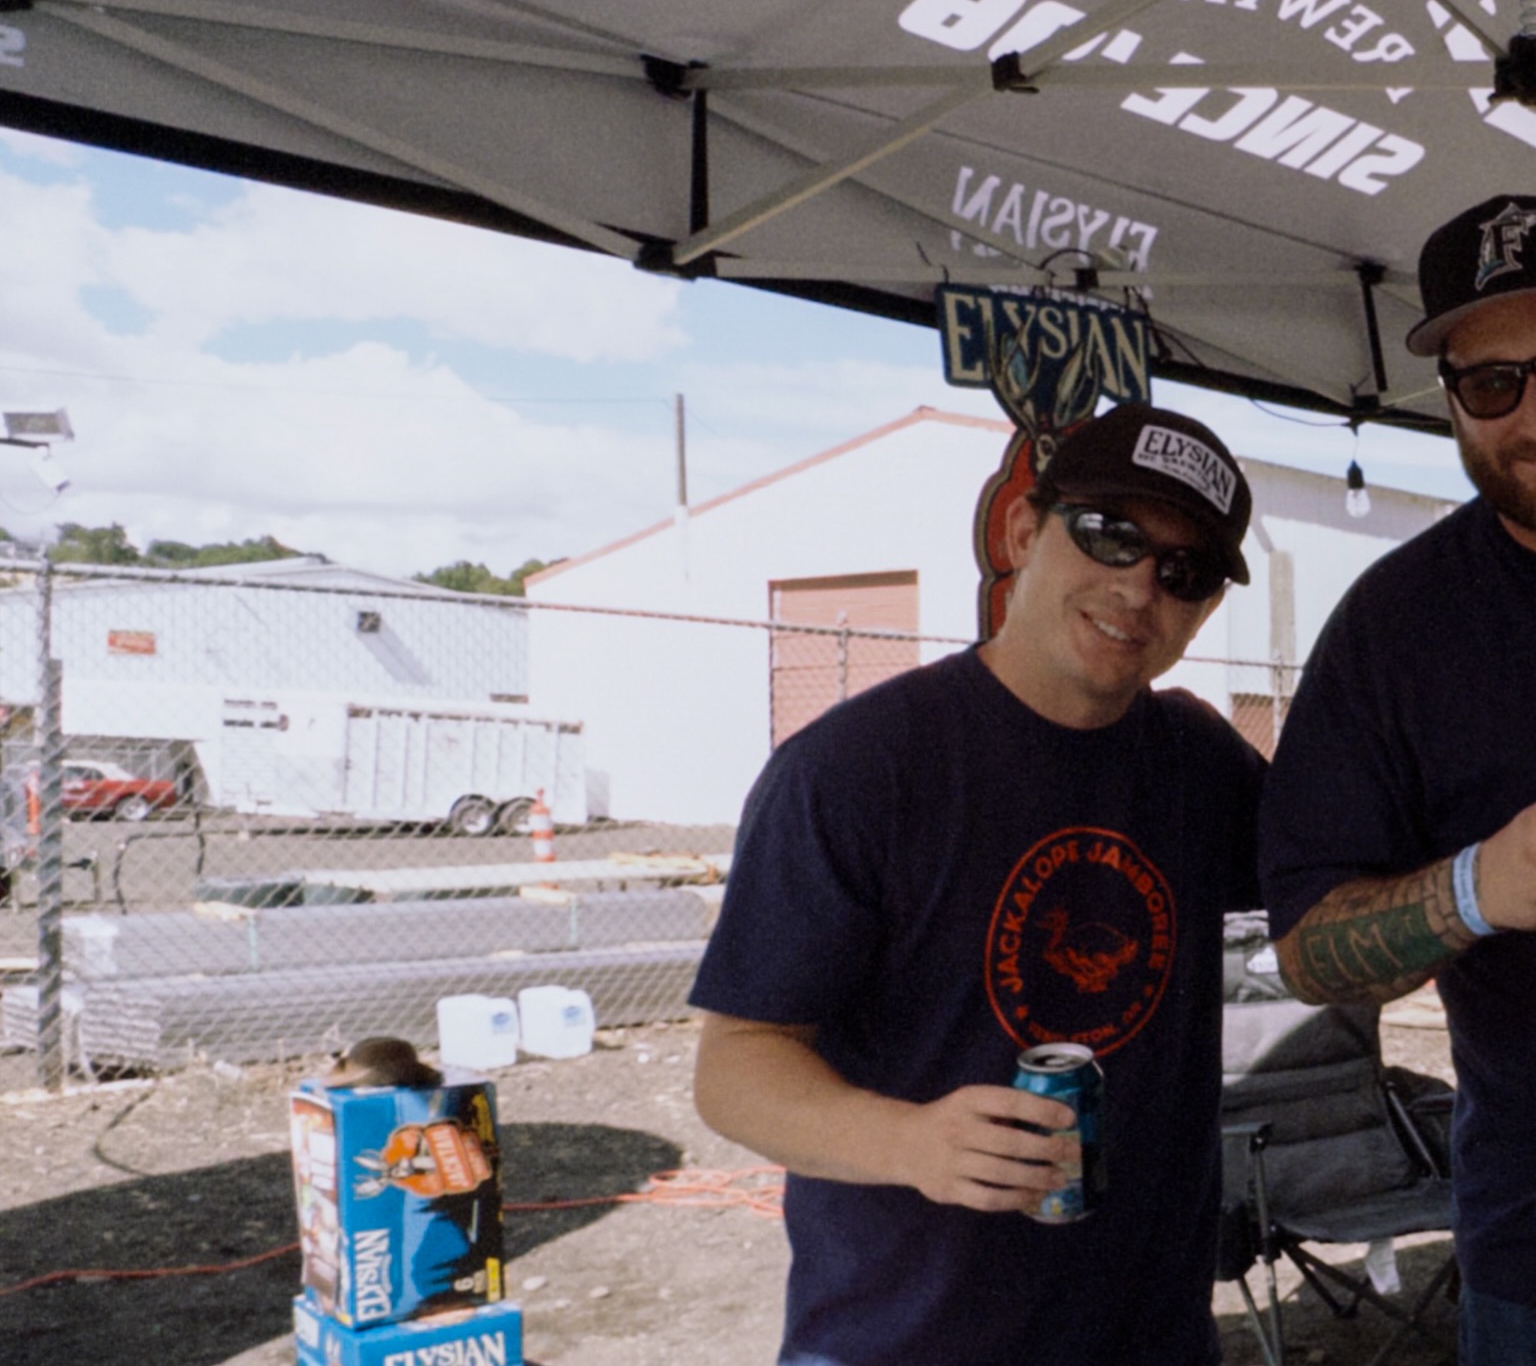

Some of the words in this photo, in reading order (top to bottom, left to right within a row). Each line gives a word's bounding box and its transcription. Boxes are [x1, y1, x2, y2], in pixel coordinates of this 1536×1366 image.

[943, 291, 1150, 401] ELYSIAN
[1142, 429, 1234, 497] ELYSIAN
[996, 839, 1080, 994] JACKALOPE
[353, 1228, 391, 1324] ELYSIAN
